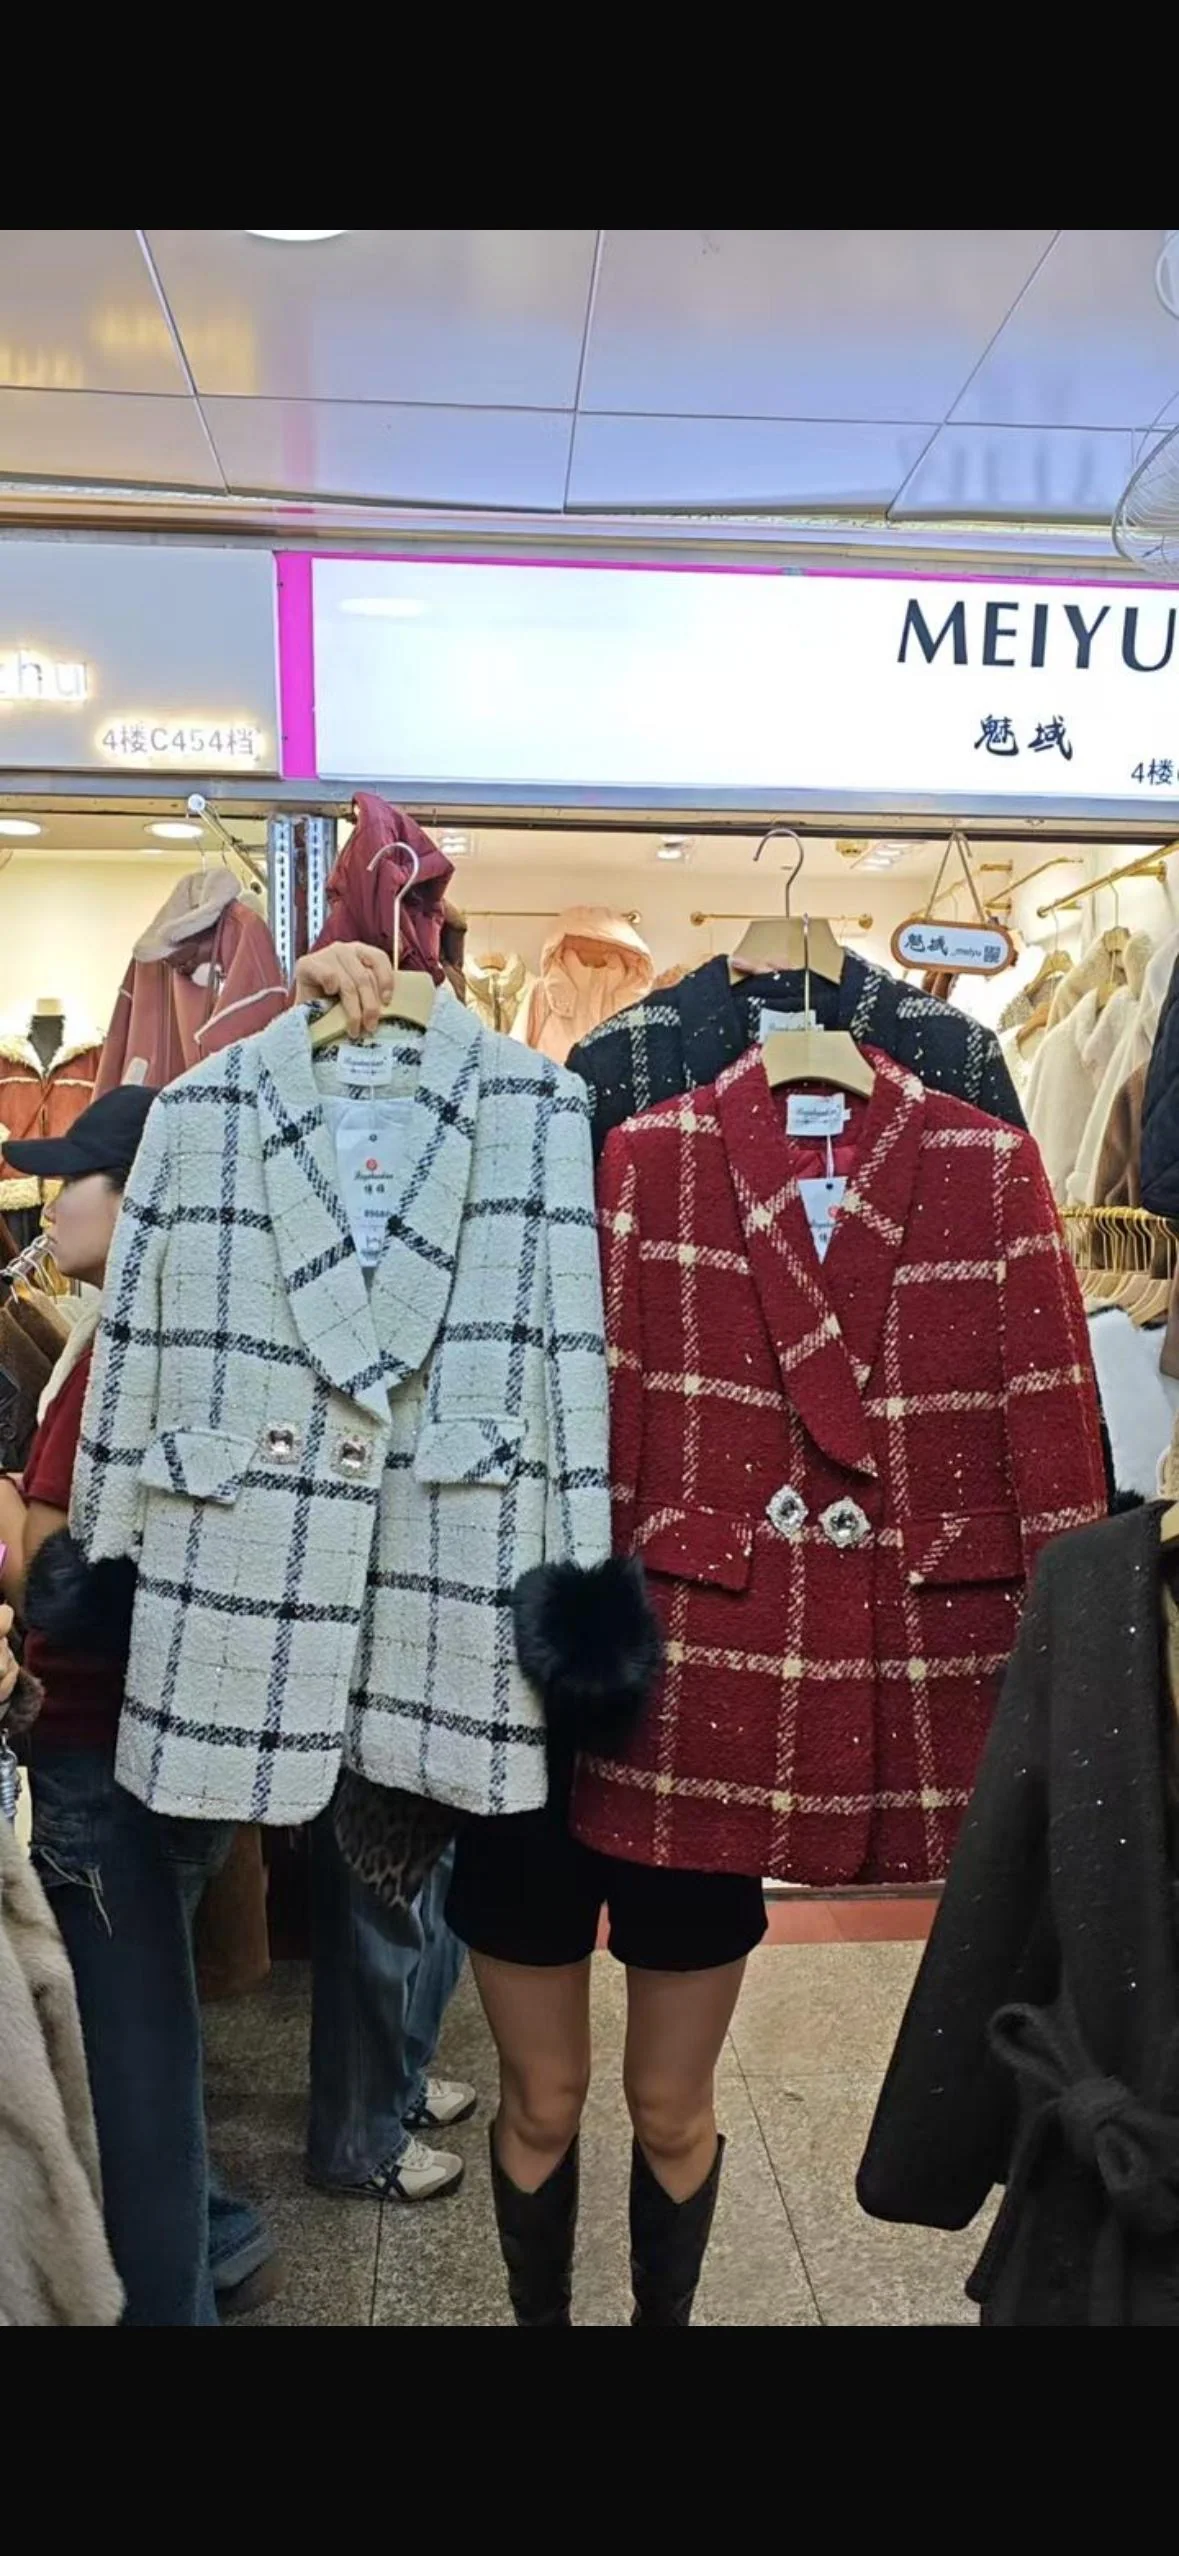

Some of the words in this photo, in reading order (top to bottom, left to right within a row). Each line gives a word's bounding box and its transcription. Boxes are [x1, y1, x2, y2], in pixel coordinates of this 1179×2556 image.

[897, 598, 1177, 672] MEIYU
[0, 652, 88, 697] hu
[102, 725, 255, 755] 4楼C454档
[974, 714, 1073, 761] 魅域
[1130, 757, 1179, 786] 4楼
